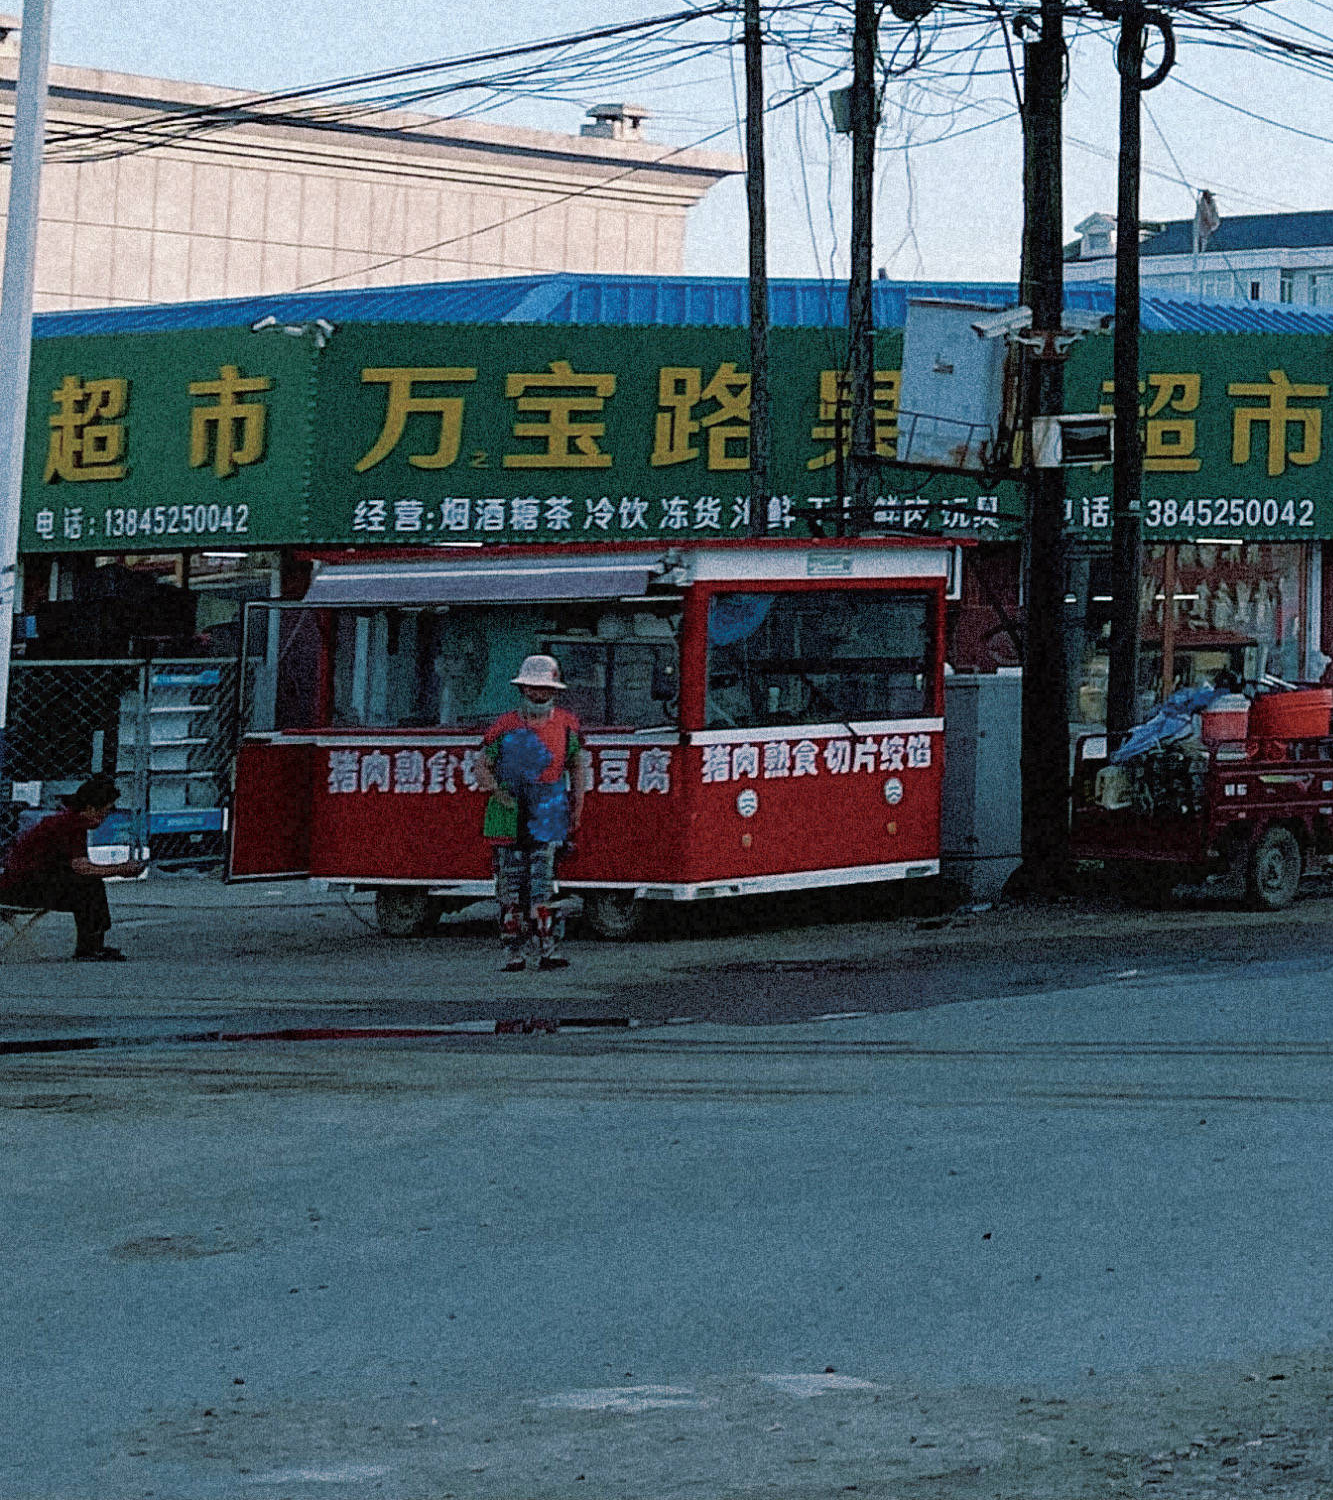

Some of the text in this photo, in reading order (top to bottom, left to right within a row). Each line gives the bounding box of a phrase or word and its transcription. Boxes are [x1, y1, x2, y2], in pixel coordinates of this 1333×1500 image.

[45, 365, 271, 481] 超市
[356, 362, 1328, 474] 万宝路果超市
[36, 504, 249, 538] 电话:13845250042
[584, 497, 648, 530] 冷饮
[660, 496, 722, 530] 冻货
